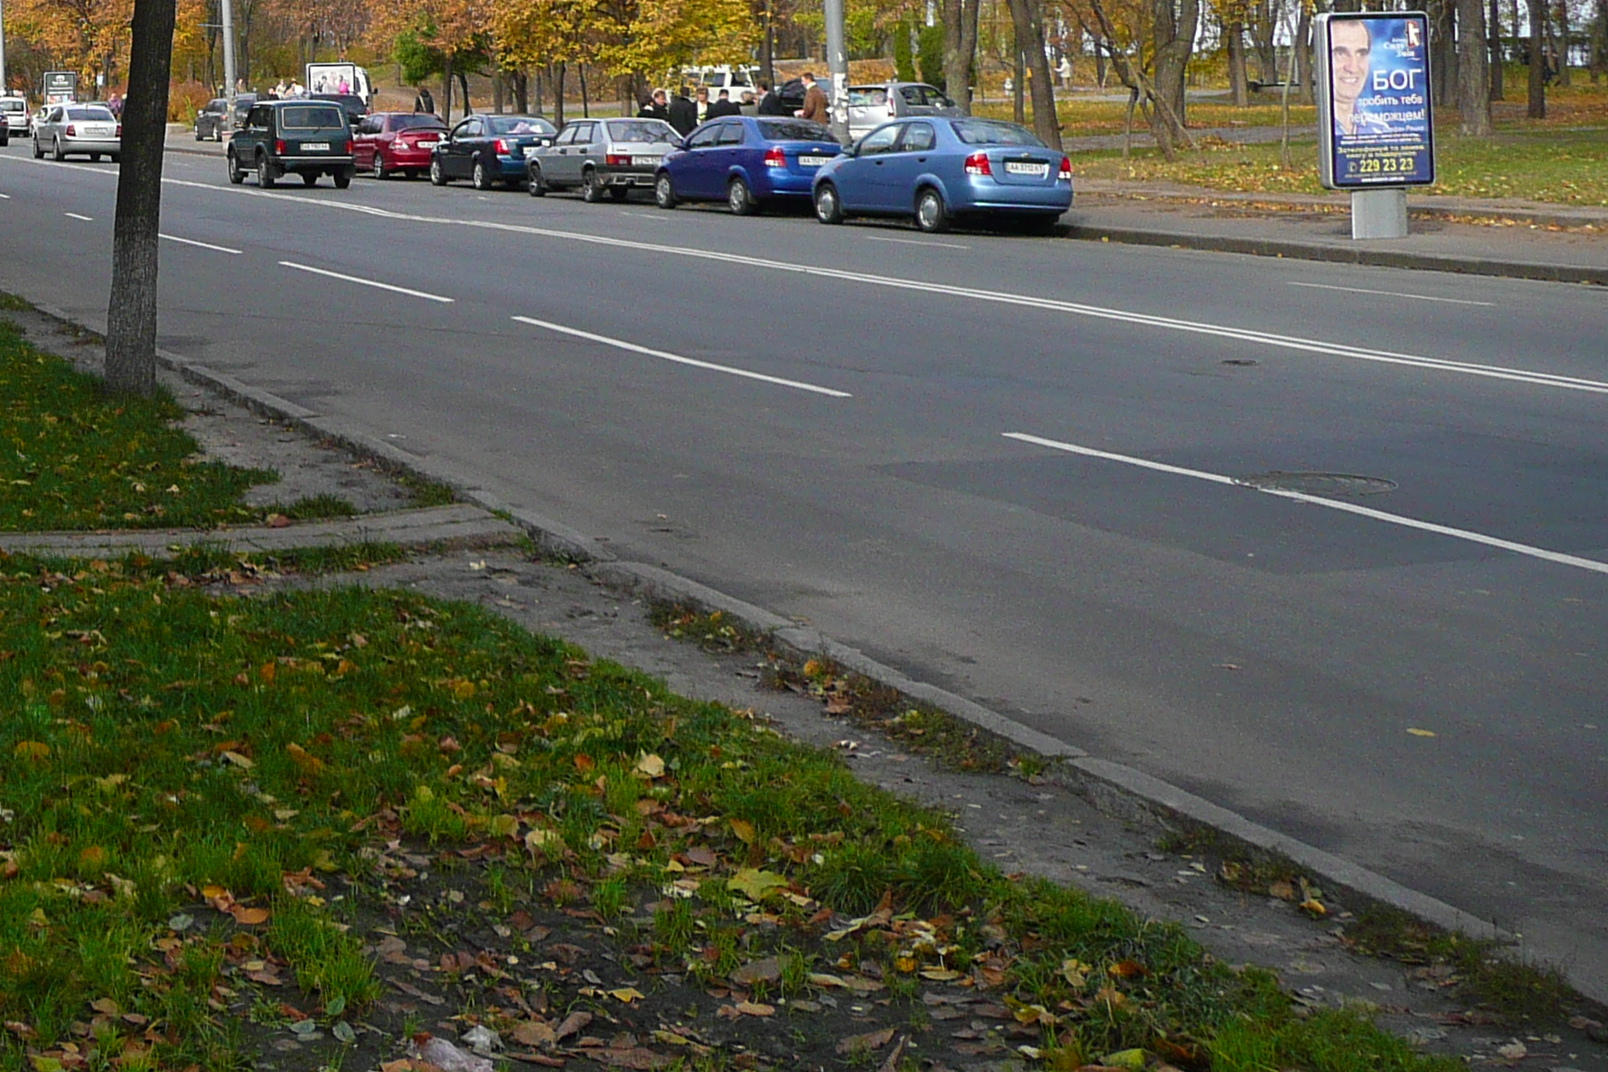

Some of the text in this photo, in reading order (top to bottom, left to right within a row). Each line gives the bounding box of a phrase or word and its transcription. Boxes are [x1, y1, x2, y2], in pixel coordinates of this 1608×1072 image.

[1373, 68, 1422, 91] БОГ
[1359, 157, 1414, 173] 229 23 23
